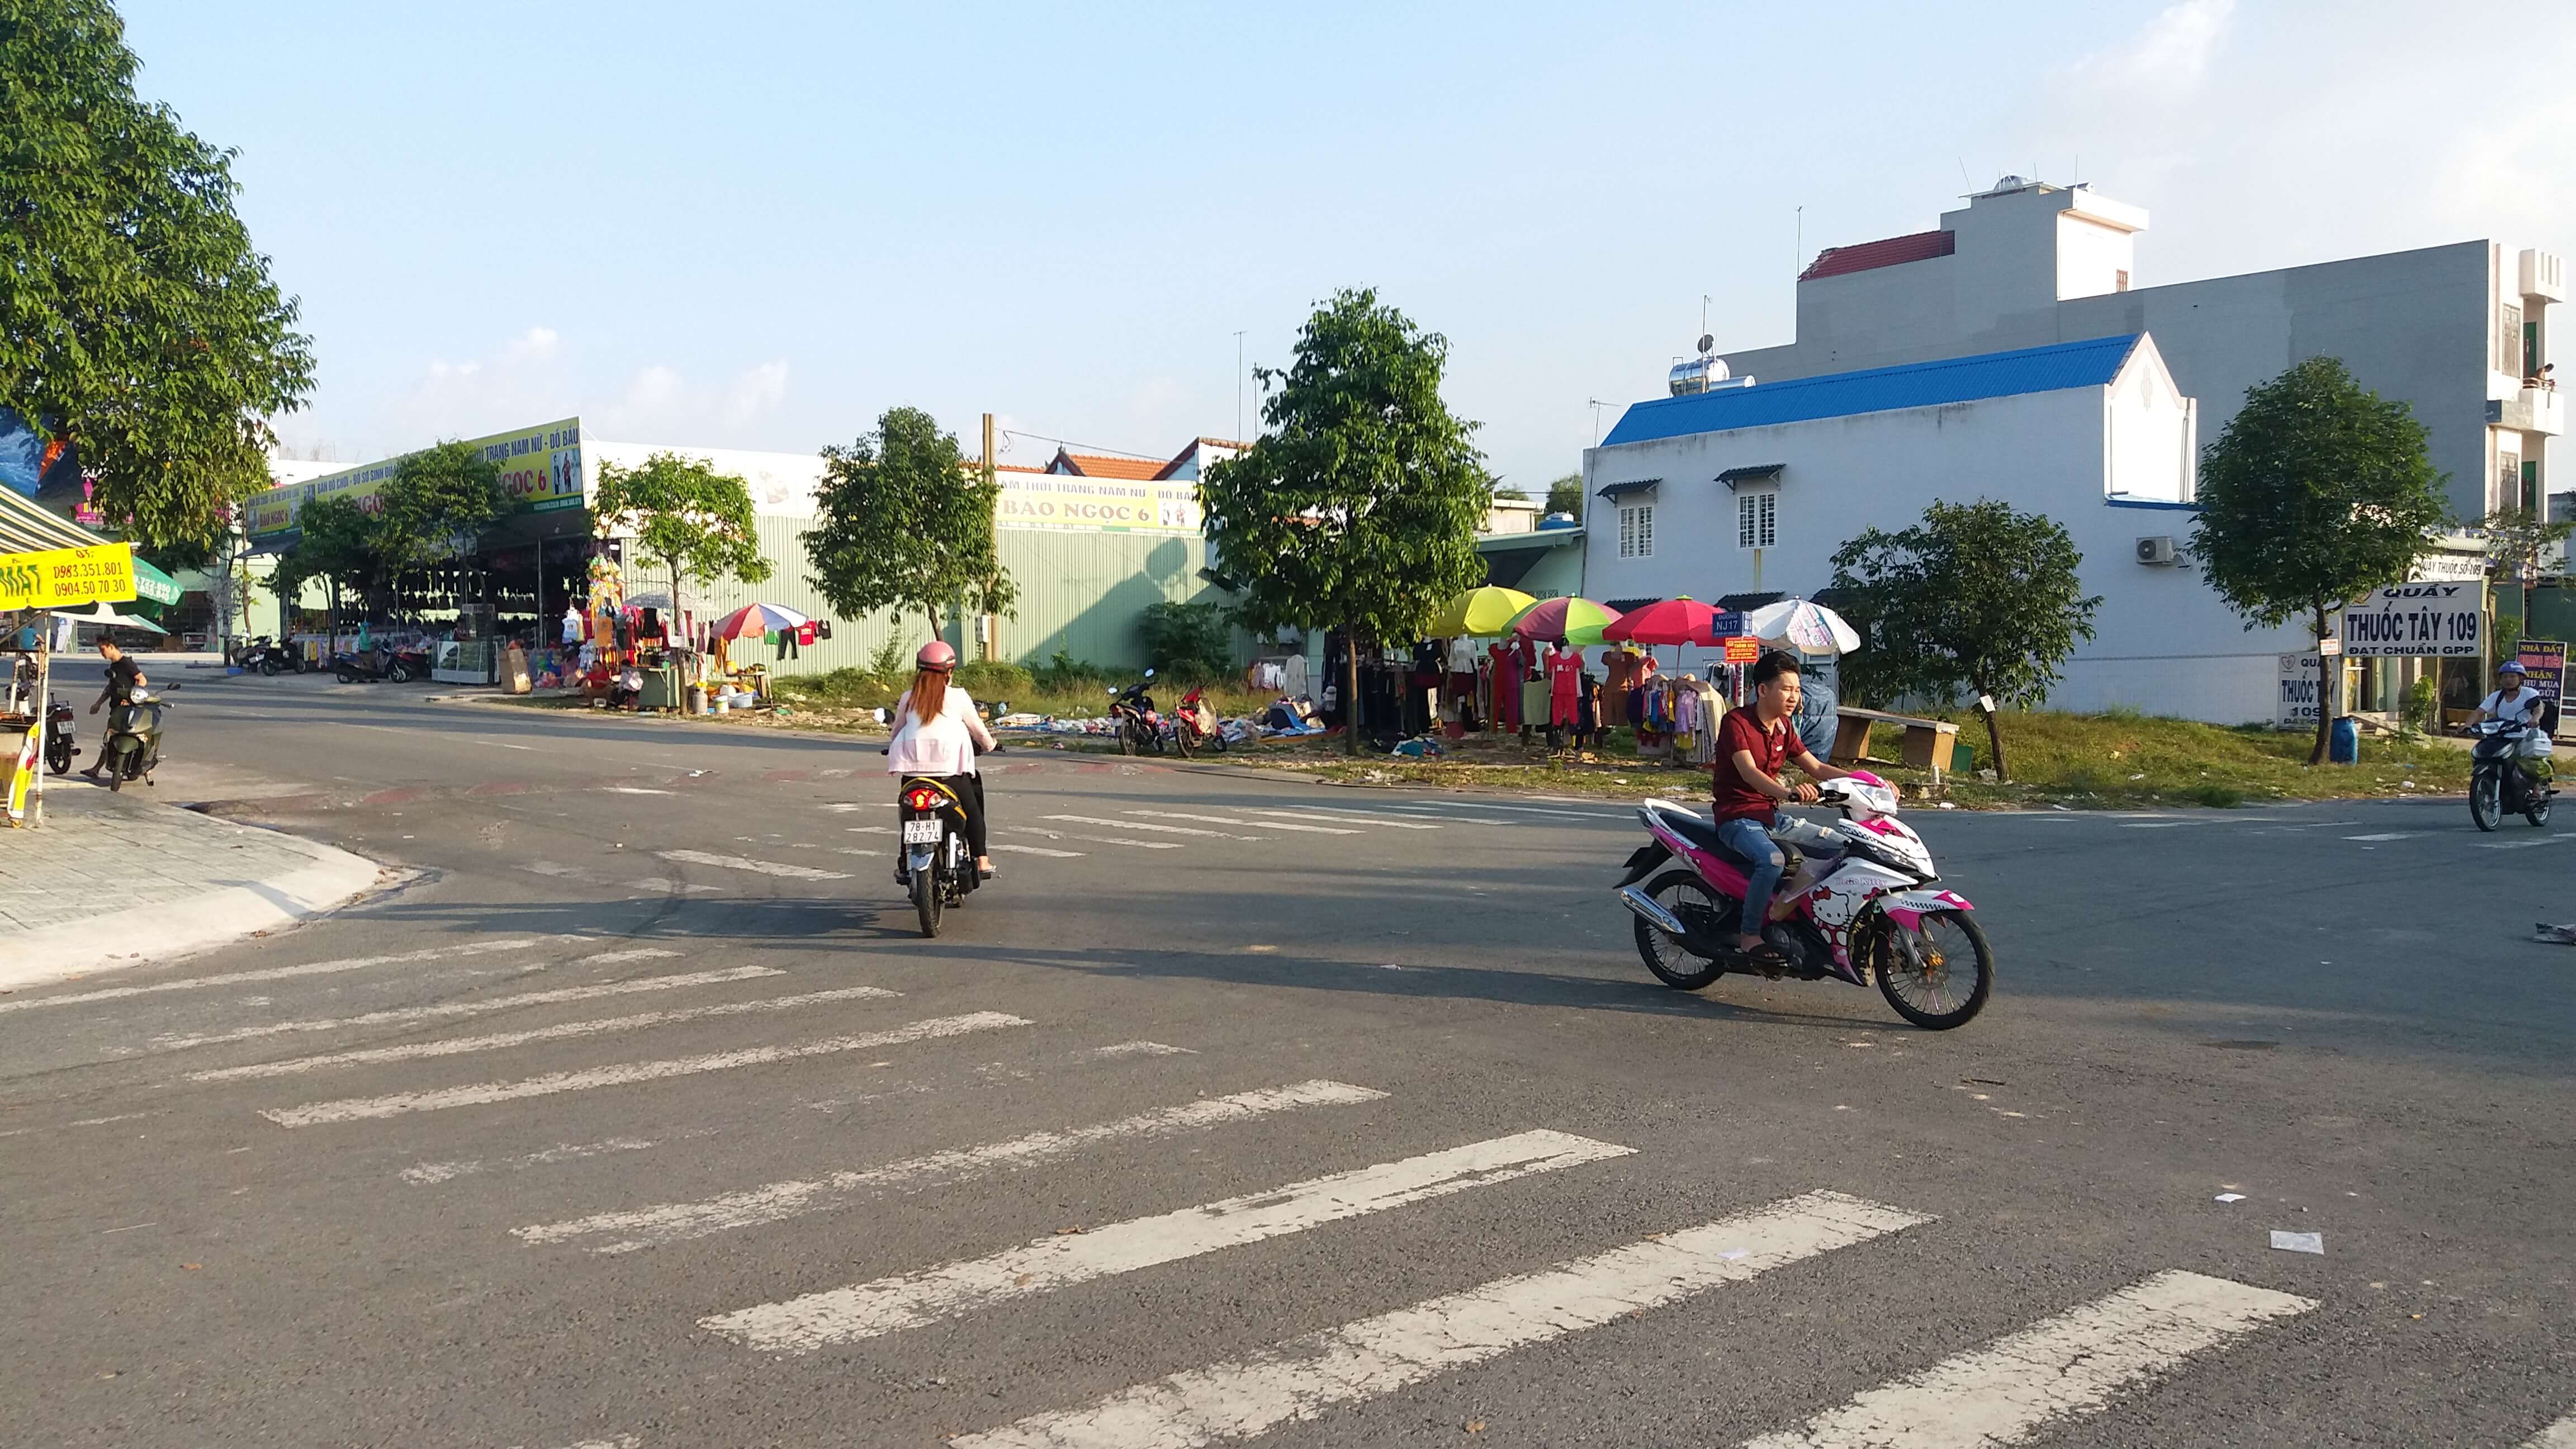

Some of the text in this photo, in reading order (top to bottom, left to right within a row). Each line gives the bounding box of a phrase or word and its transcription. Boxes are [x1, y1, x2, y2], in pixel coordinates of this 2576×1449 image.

[485, 443, 510, 461] TRANG
[511, 438, 529, 457] NAM
[538, 469, 547, 491] 6
[1057, 482, 1094, 494] TRANG
[1099, 485, 1125, 496] NAM
[1003, 494, 1149, 523] BẢO NGỌC 6
[54, 562, 123, 579] 0983.351.801
[2470, 564, 2482, 575] 109
[55, 579, 126, 596] 0904.50 70 30
[1716, 620, 1738, 631] NJ17
[2347, 600, 2476, 641] THUỐC TÂY 109
[2348, 647, 2379, 657] ĐẠT
[2383, 642, 2437, 655] CHUẨN
[2442, 646, 2474, 654] GPP
[2520, 643, 2563, 653] NHÀ ĐẤT
[2281, 670, 2336, 703] THUỐC TY
[2289, 707, 2321, 717] 109
[906, 831, 939, 841] 282.74
